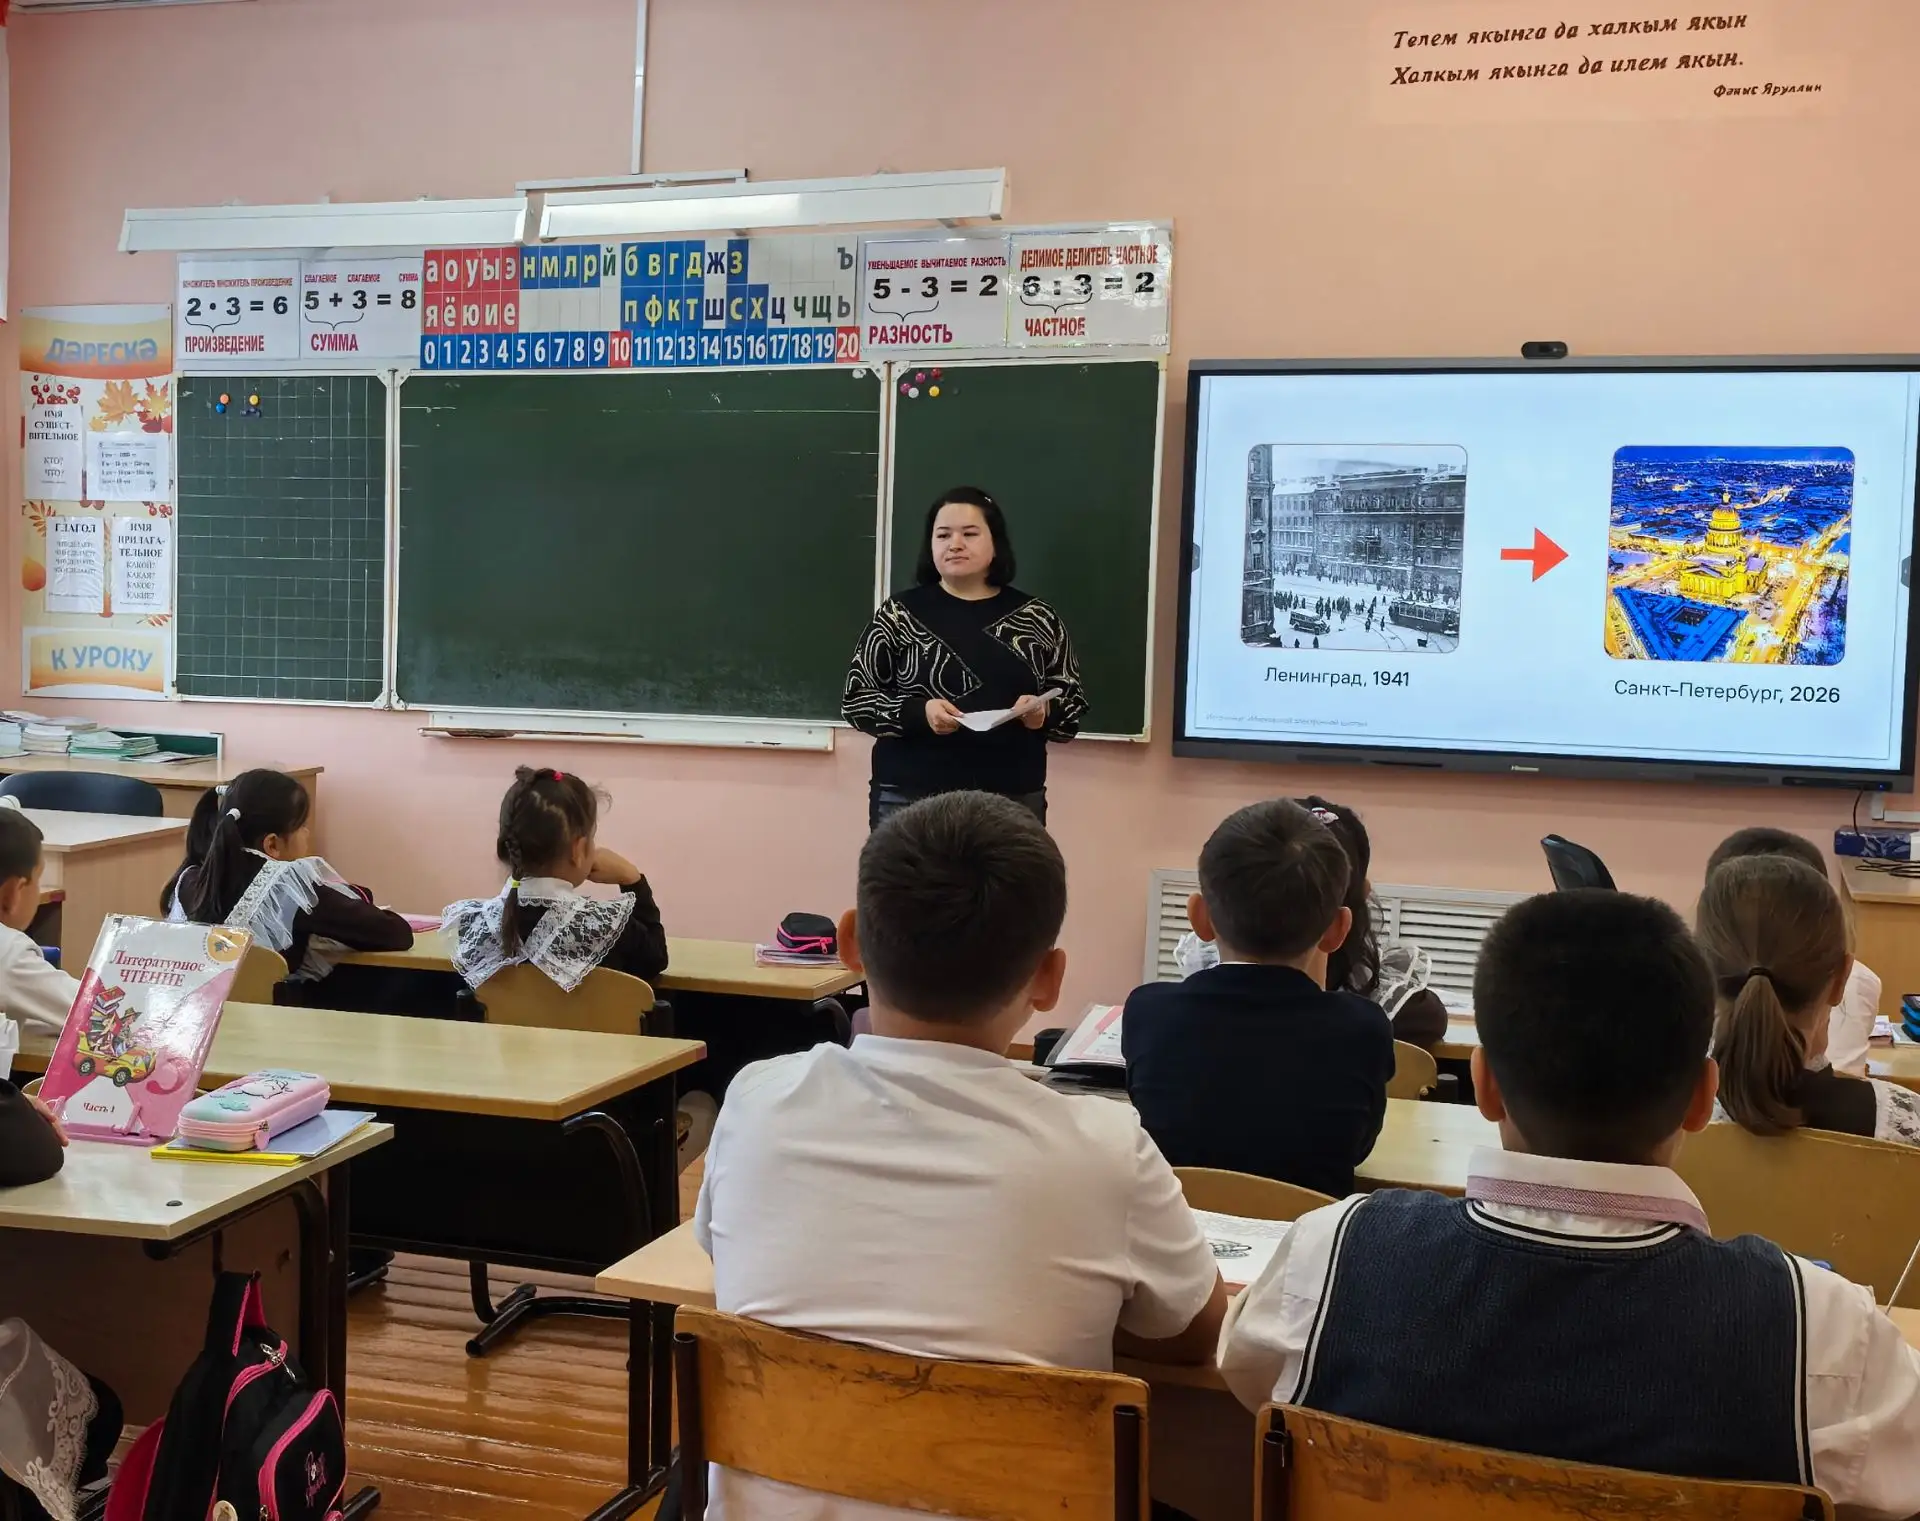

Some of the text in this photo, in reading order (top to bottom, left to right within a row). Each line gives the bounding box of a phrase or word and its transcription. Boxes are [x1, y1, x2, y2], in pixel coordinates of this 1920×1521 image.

[1394, 31, 1457, 48] Телем
[1468, 27, 1547, 44] якынга
[1555, 22, 1578, 39] да
[1588, 18, 1677, 37] халкым
[1390, 67, 1479, 84] Халкым
[1489, 63, 1568, 79] якынга
[1579, 56, 1603, 74] да
[1611, 57, 1668, 72] илем
[868, 256, 1006, 270] УМЕНЬШАЕМОЕ ВЫЧИТАЕМОЕ РАЗНОСТЬ
[1020, 248, 1063, 271] ДЕЛИМОЕ
[874, 279, 891, 298] 5
[921, 277, 938, 298] 3
[951, 280, 967, 292] =
[980, 275, 998, 296] 2
[1023, 276, 1040, 296] 6
[1074, 274, 1092, 295] 3
[1105, 278, 1122, 289] =
[1136, 272, 1154, 292] 2
[187, 298, 201, 316] 2
[226, 297, 240, 315] 3
[250, 301, 263, 311] =
[273, 296, 288, 315] 6
[305, 290, 416, 309] 5 + 3 = 8
[869, 324, 952, 344] РАЗНОСТЬ
[1025, 318, 1085, 337] ЧАСТНОЕ
[185, 336, 264, 354] ПРОИЗВЕДЕНИЕ
[311, 334, 358, 351] СУММА
[424, 333, 858, 364] 0 1 2 3 4 5 6 7 8 9 10 11 12 13 14 15 16 17 18 19 20
[55, 523, 96, 533] ГЛАГОЛ
[52, 646, 153, 671] К УРОКУ
[1265, 667, 1409, 687] Ленинград, 1941
[1790, 686, 1840, 703] 2026
[110, 950, 205, 972] Литературное
[120, 969, 185, 987] ЧТЕНИЕ
[84, 1102, 108, 1113] Часть
